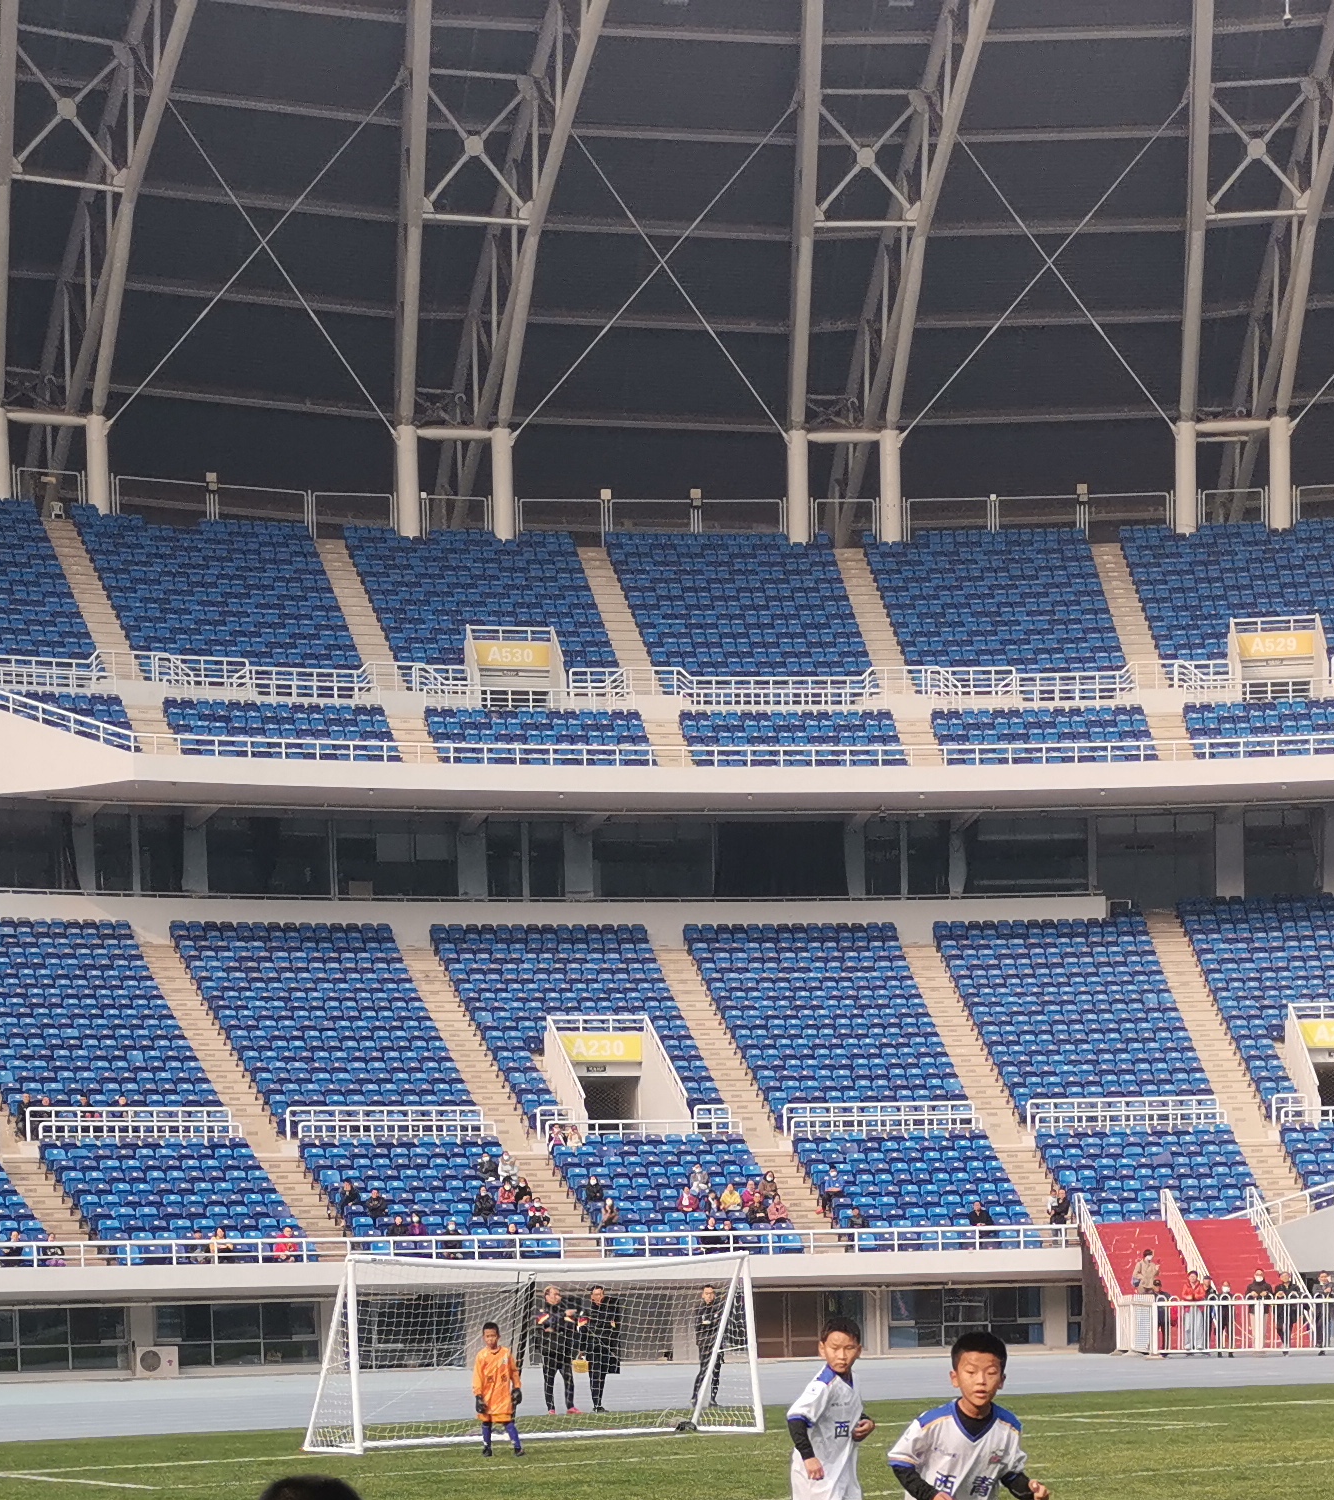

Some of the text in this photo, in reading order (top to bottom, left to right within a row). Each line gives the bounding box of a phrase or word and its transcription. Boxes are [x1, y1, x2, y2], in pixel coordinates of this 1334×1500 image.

[1250, 637, 1298, 653] A529
[487, 646, 534, 663] A530
[572, 1038, 625, 1057] A230
[834, 1420, 850, 1439] 西
